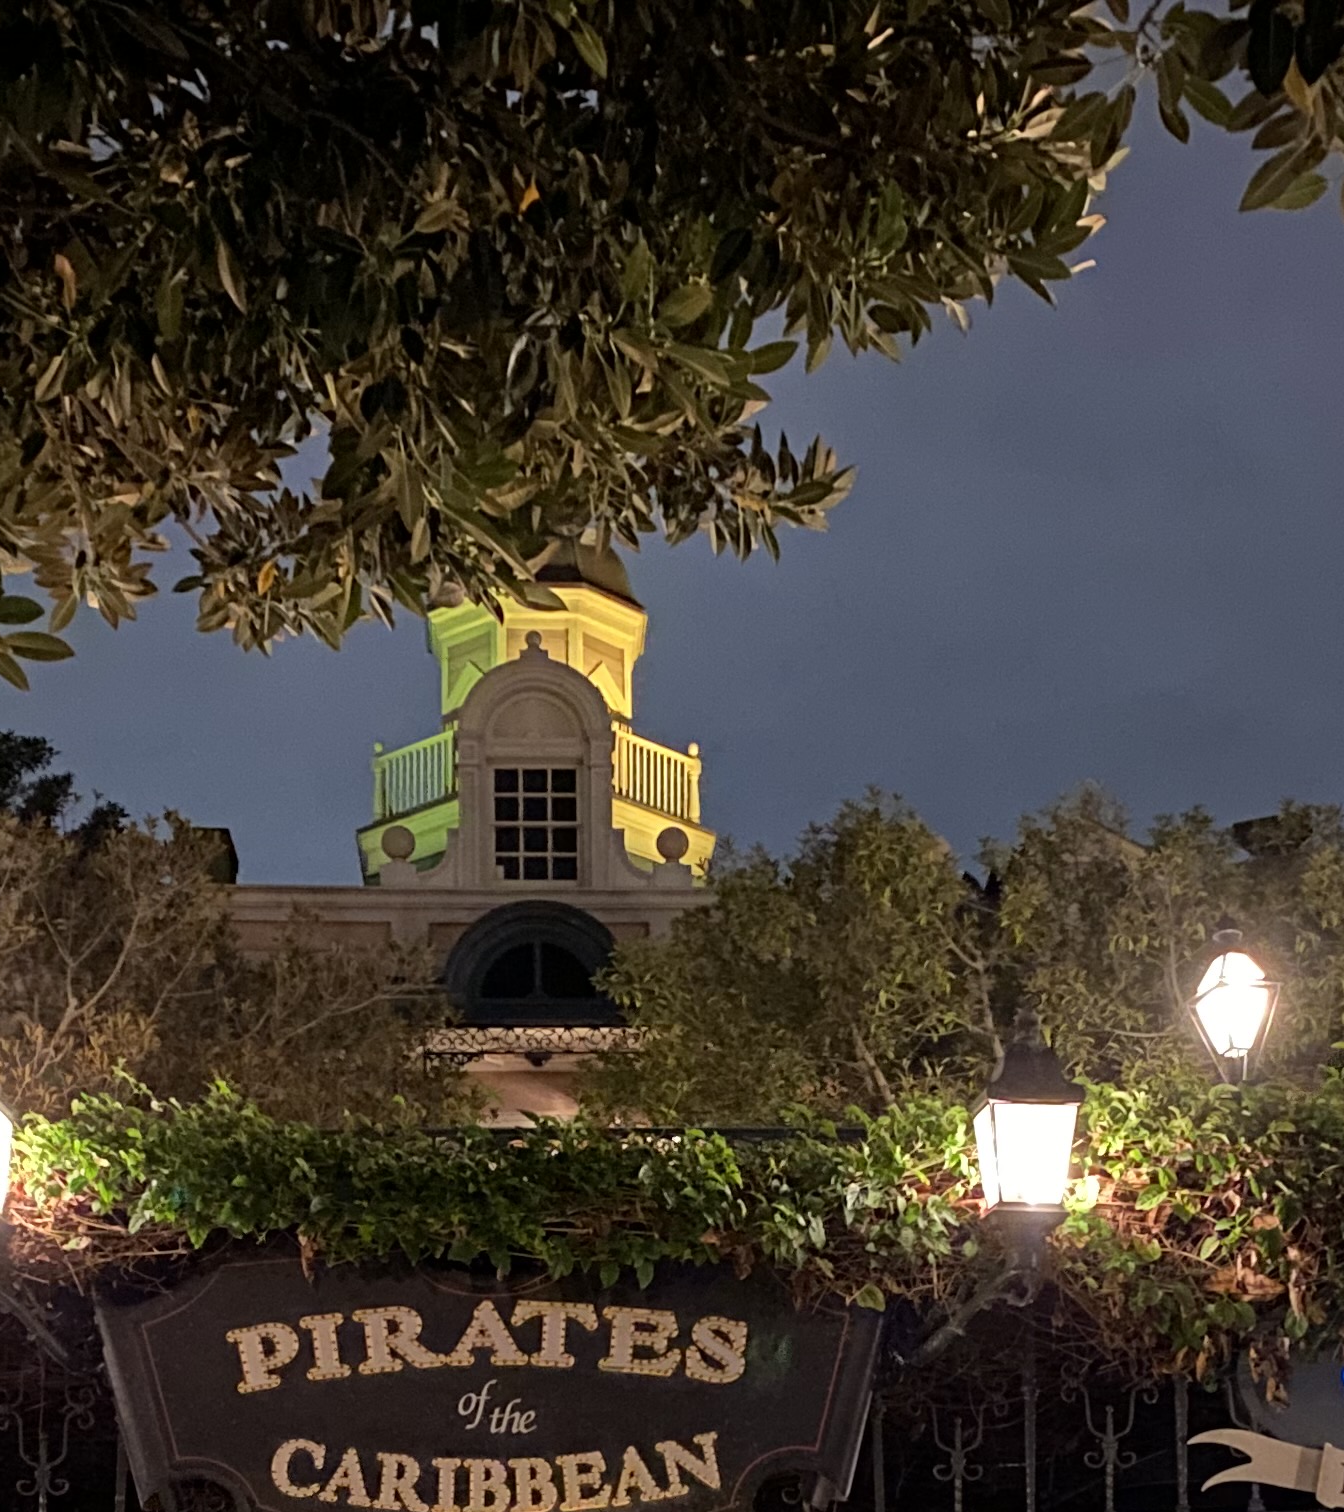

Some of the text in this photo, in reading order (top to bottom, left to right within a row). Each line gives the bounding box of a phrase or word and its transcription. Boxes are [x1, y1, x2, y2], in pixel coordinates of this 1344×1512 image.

[225, 1299, 749, 1394] PIRATES
[457, 1379, 537, 1435] of the
